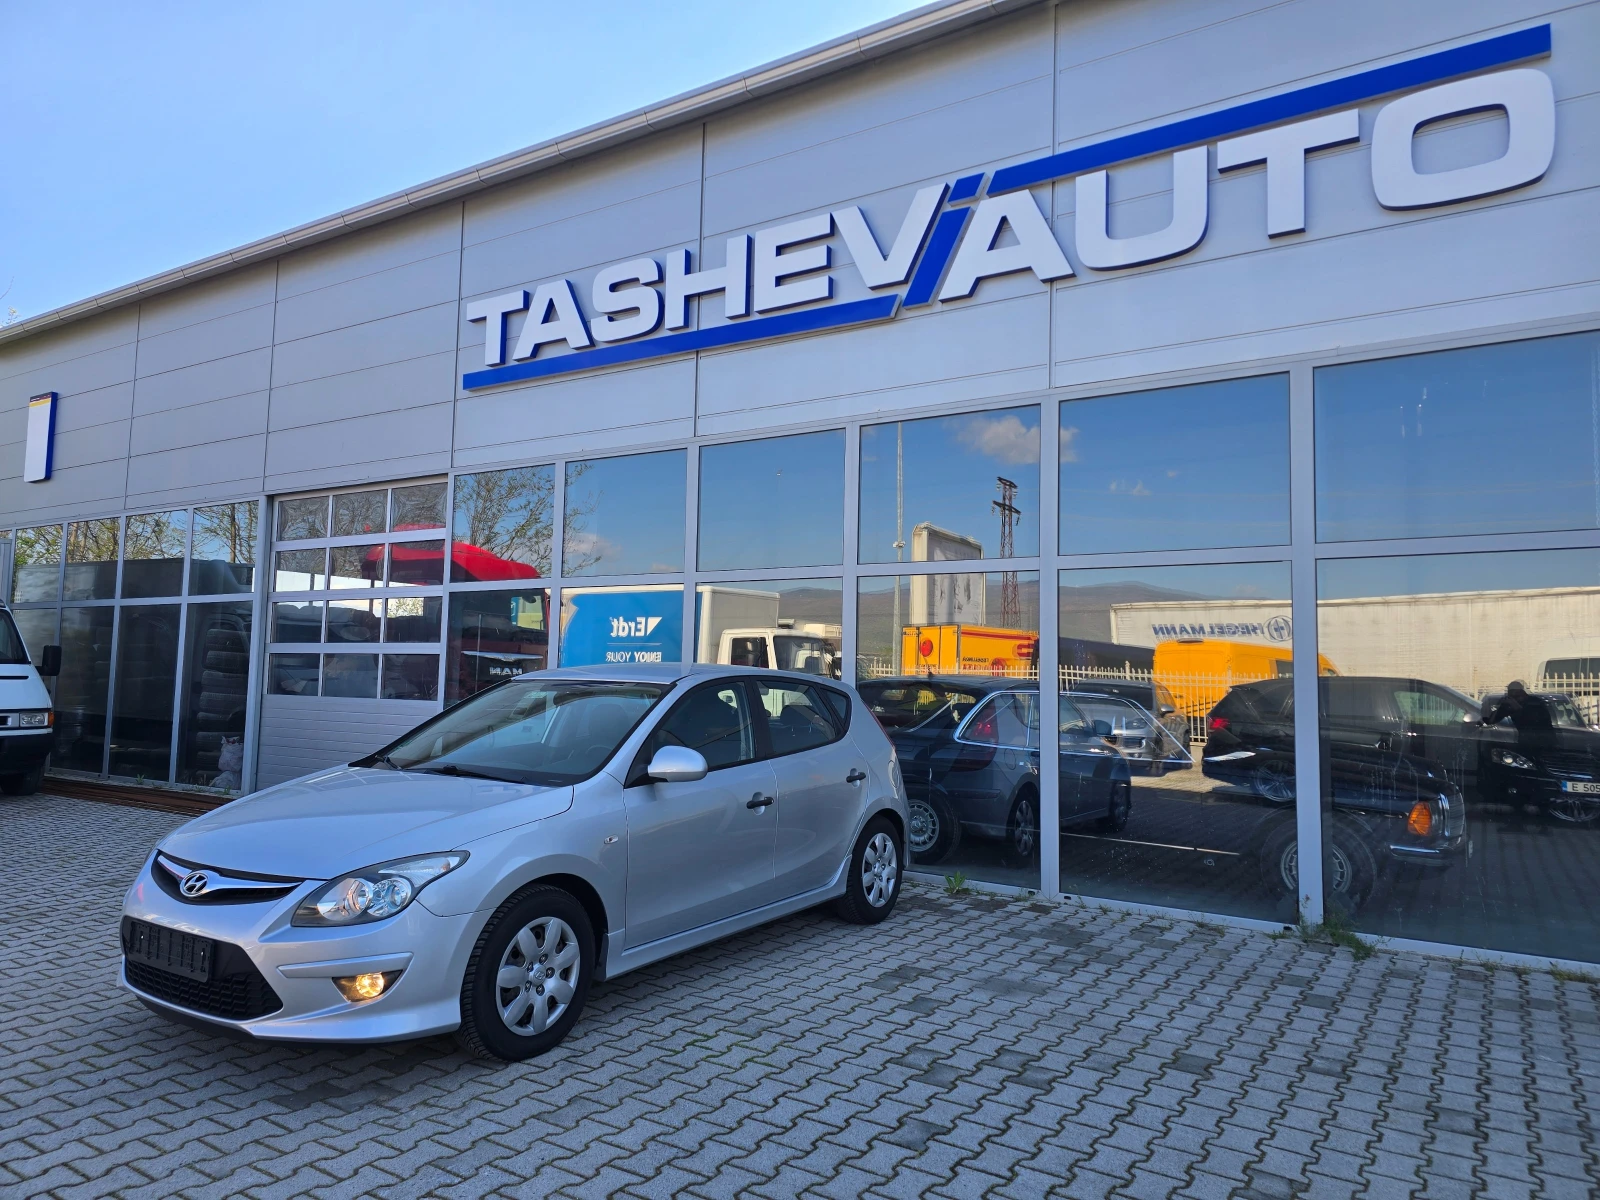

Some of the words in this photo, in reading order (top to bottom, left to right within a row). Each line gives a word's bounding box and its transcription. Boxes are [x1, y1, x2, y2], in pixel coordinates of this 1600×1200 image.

[466, 182, 951, 367] TASHEV
[938, 68, 1556, 303] AUTO
[1572, 783, 1579, 791] E
